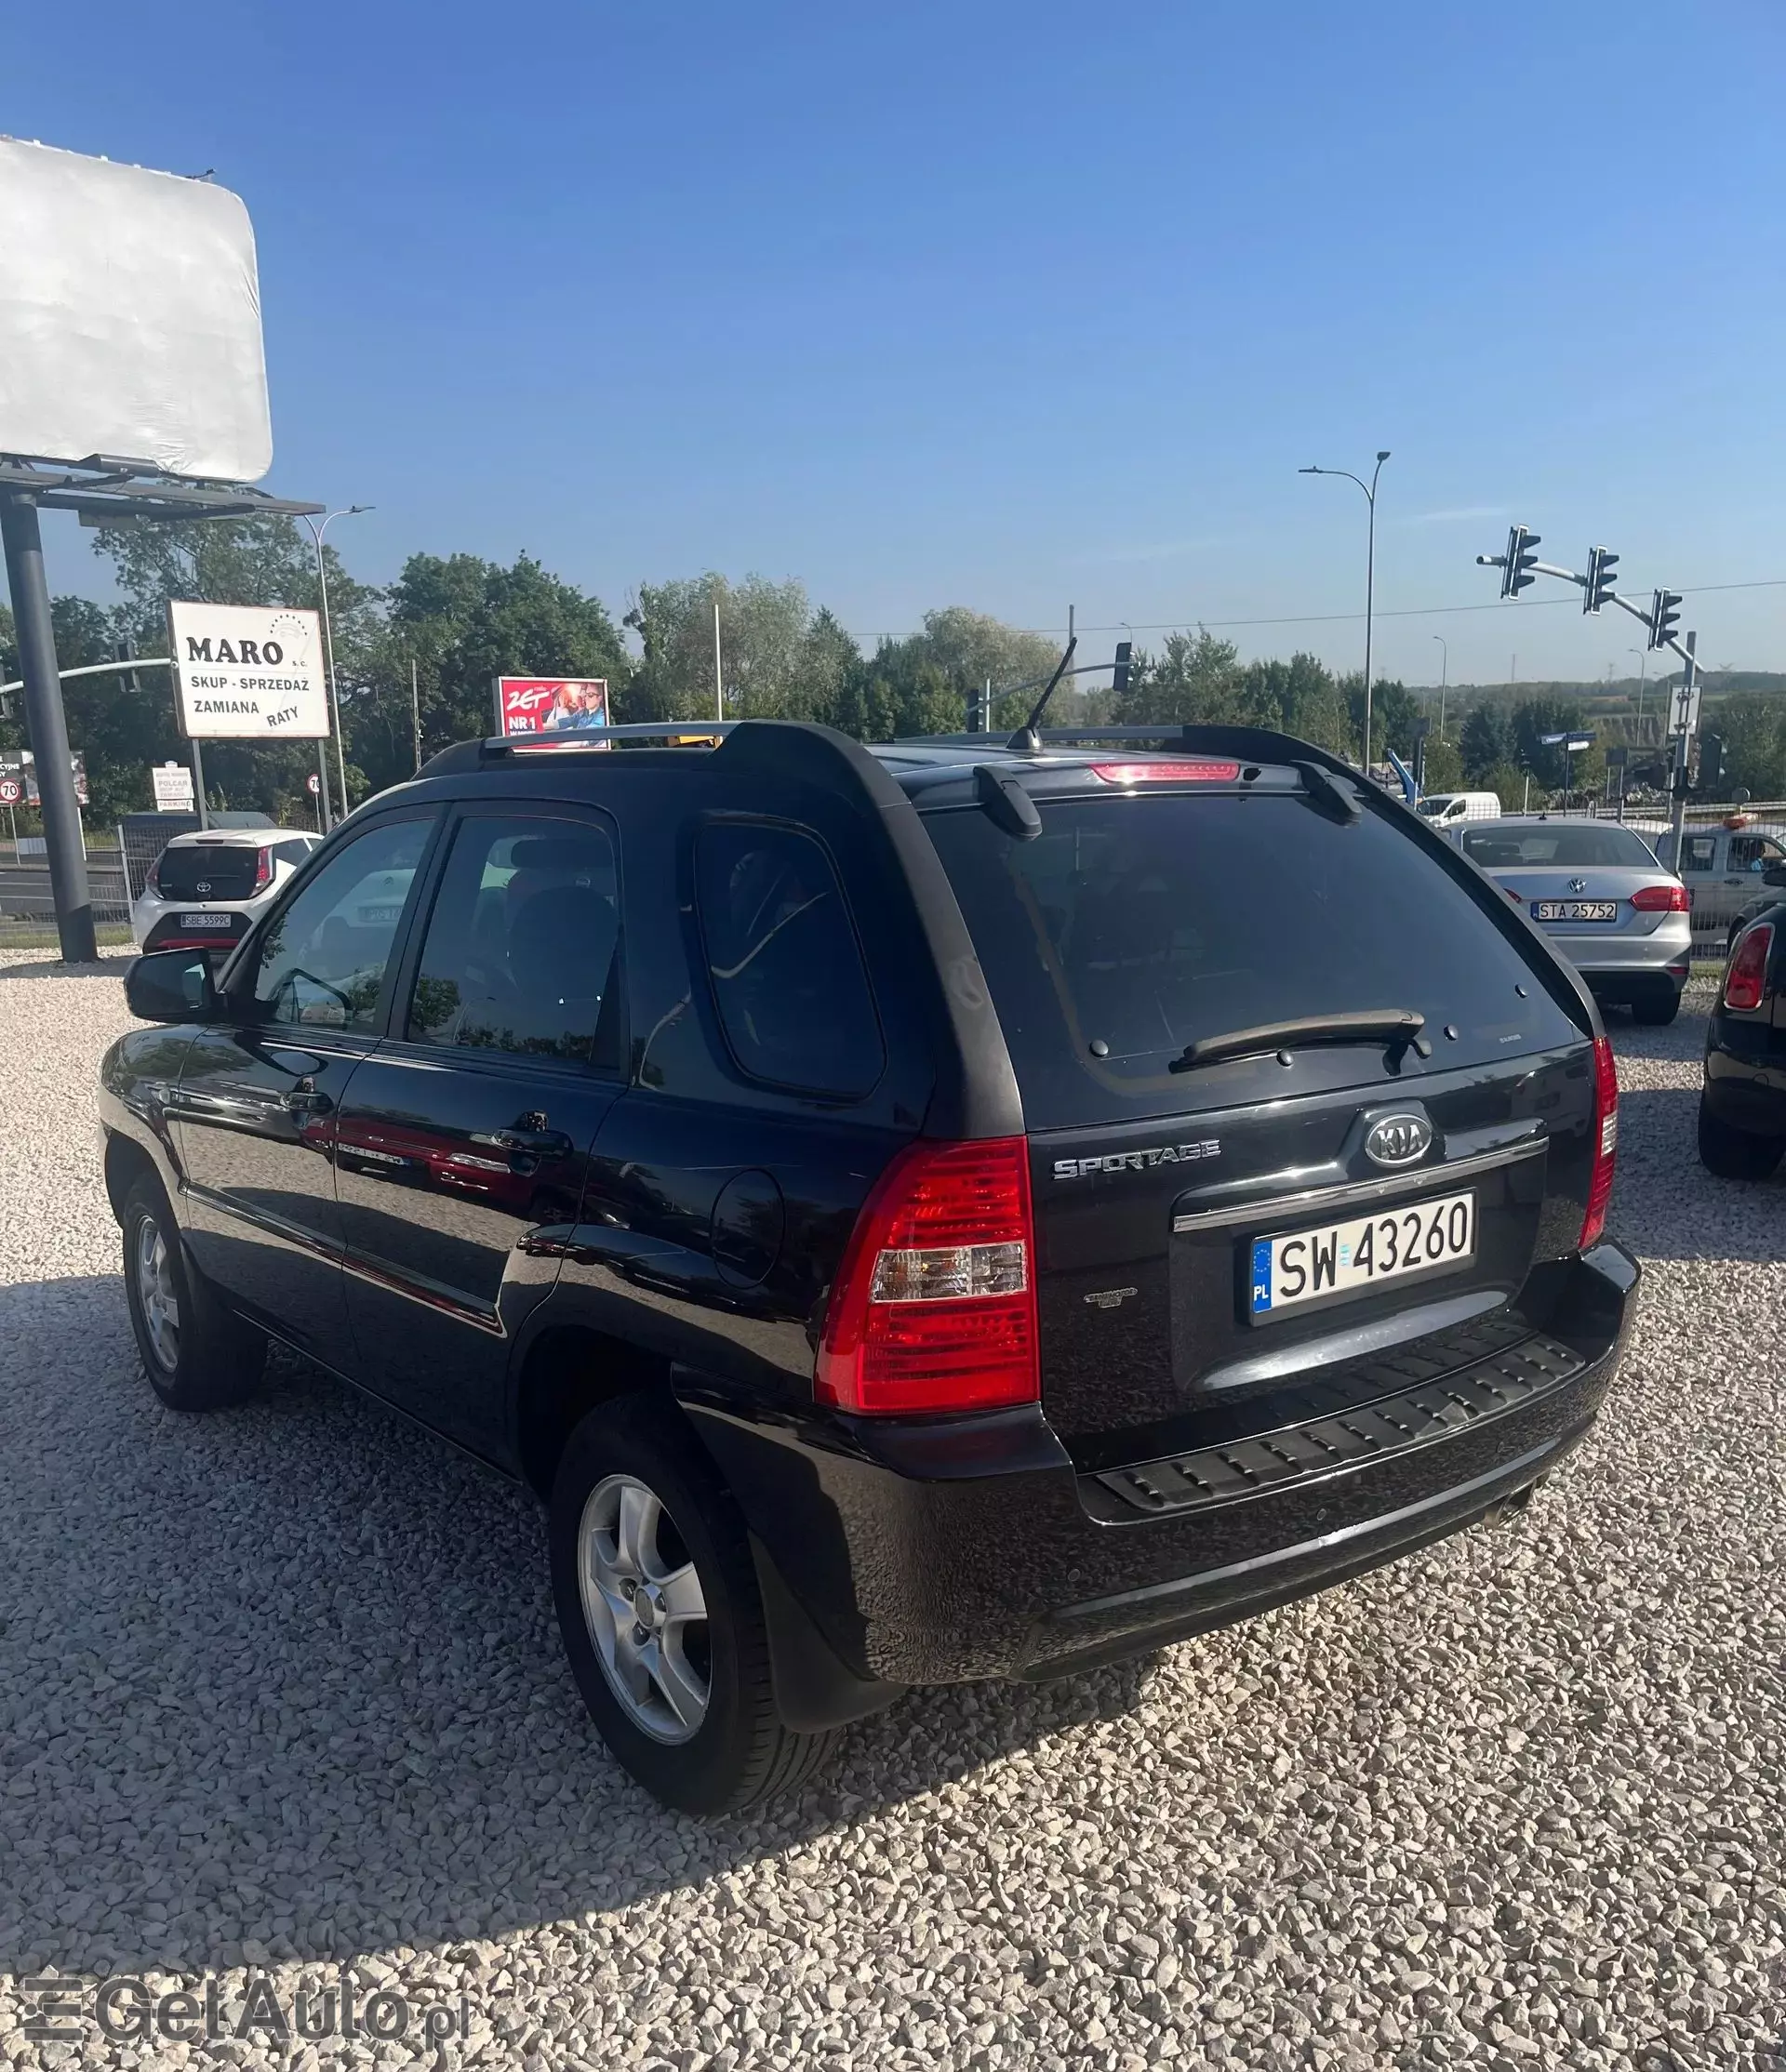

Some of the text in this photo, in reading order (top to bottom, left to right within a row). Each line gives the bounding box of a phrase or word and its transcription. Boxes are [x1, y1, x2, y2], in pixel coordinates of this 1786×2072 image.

[186, 637, 284, 666] MARO
[191, 676, 228, 688] SKUP
[240, 677, 310, 691] SPRZEDAŻ
[193, 700, 260, 713] ZAMIANA
[266, 706, 299, 727] RATY
[508, 716, 536, 730] NR 1
[3, 785, 17, 797] 70
[1540, 904, 1615, 918] STA 25752
[186, 915, 202, 925] SBE
[1377, 1123, 1424, 1161] KIA
[1052, 1139, 1222, 1180] SPORTAGE
[1280, 1201, 1468, 1297] SW 43260
[1253, 1284, 1270, 1302] PL
